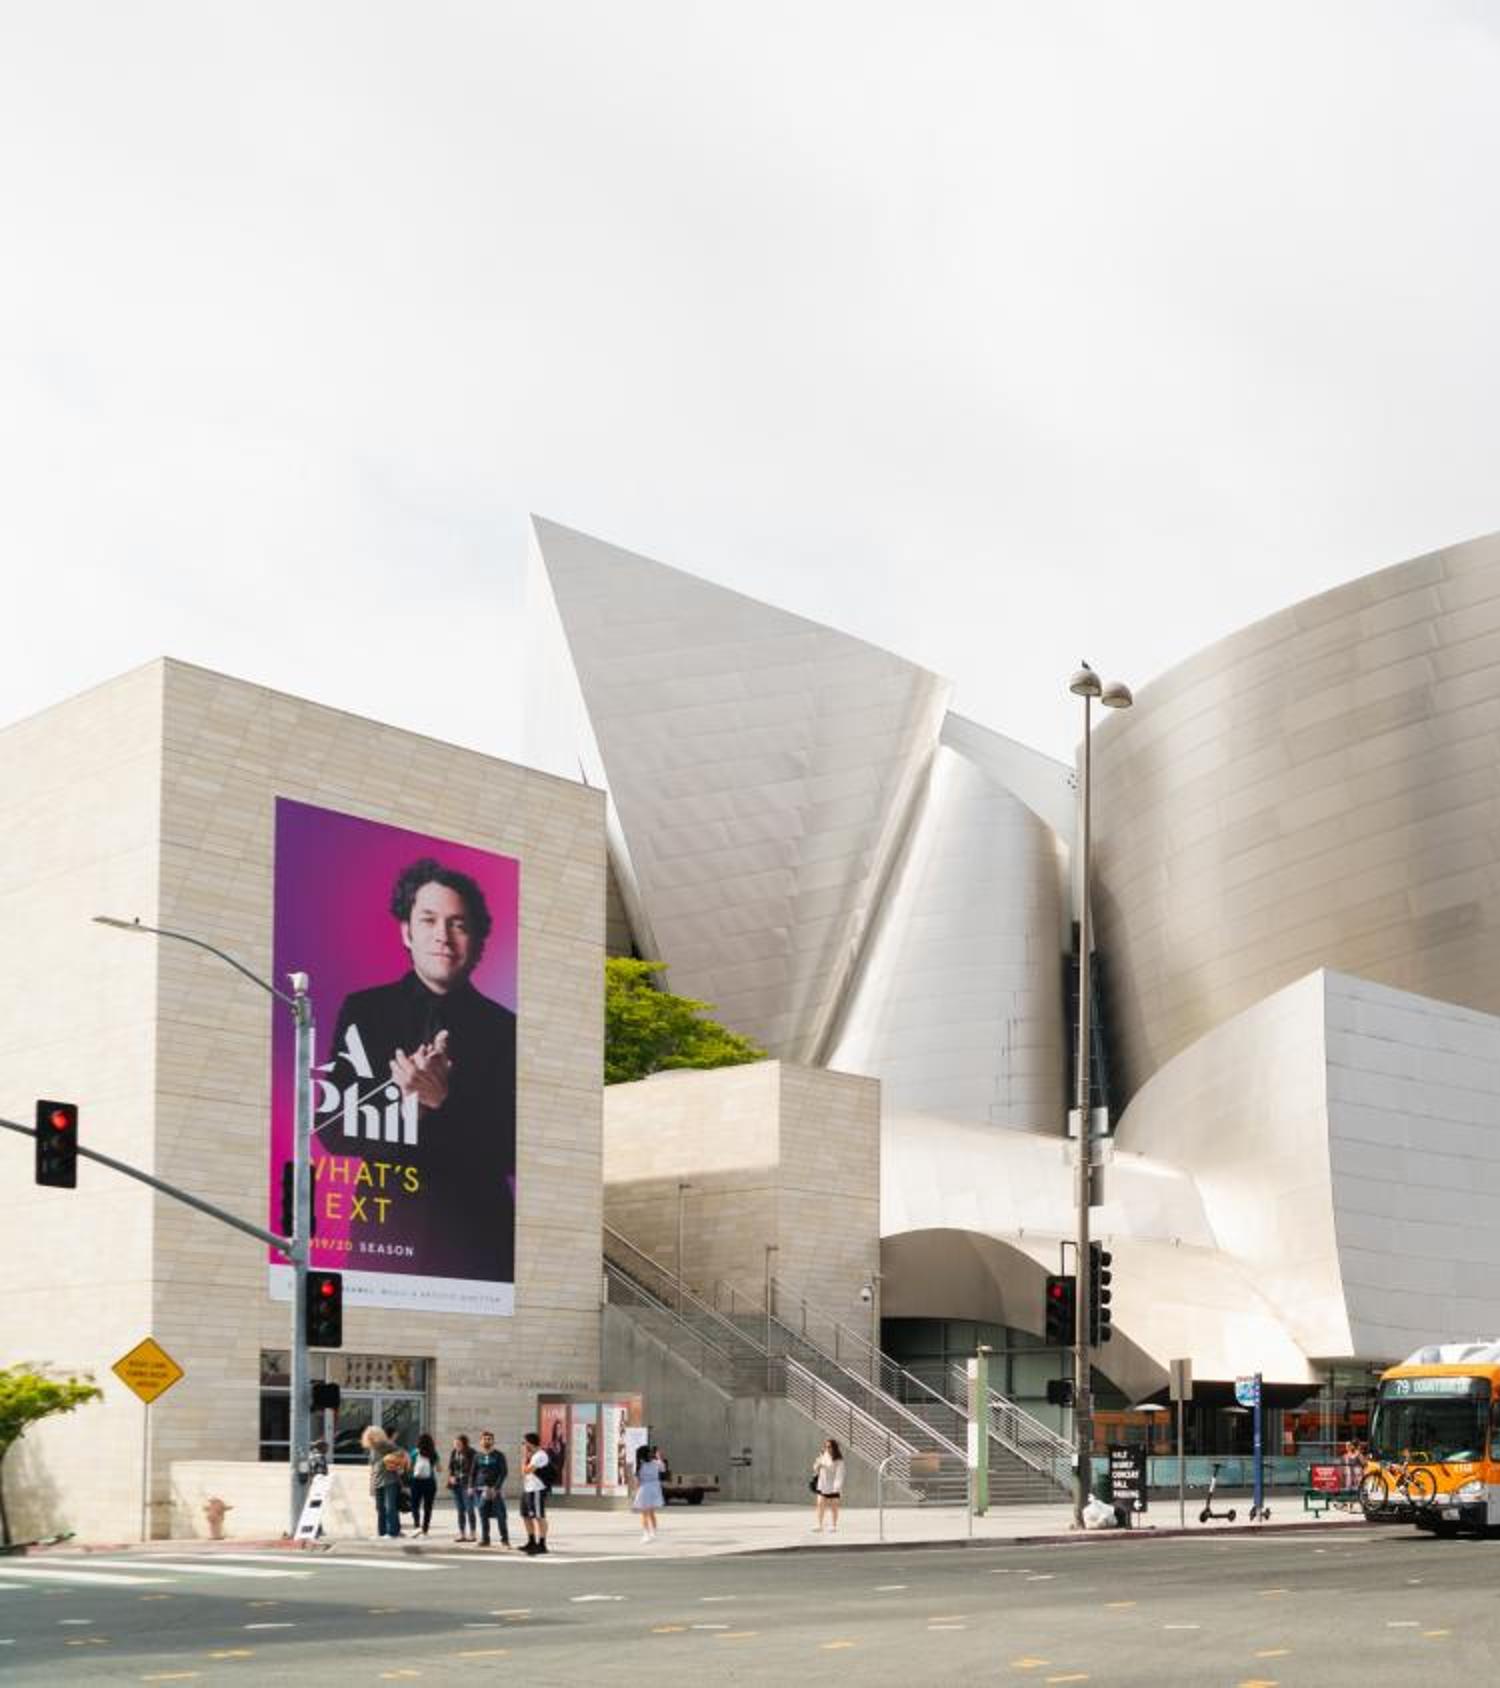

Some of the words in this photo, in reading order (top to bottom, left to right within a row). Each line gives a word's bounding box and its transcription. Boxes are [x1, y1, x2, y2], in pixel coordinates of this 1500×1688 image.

[309, 1078, 418, 1146] Phil
[325, 1192, 392, 1224] EXT
[359, 1241, 415, 1257] SEASON
